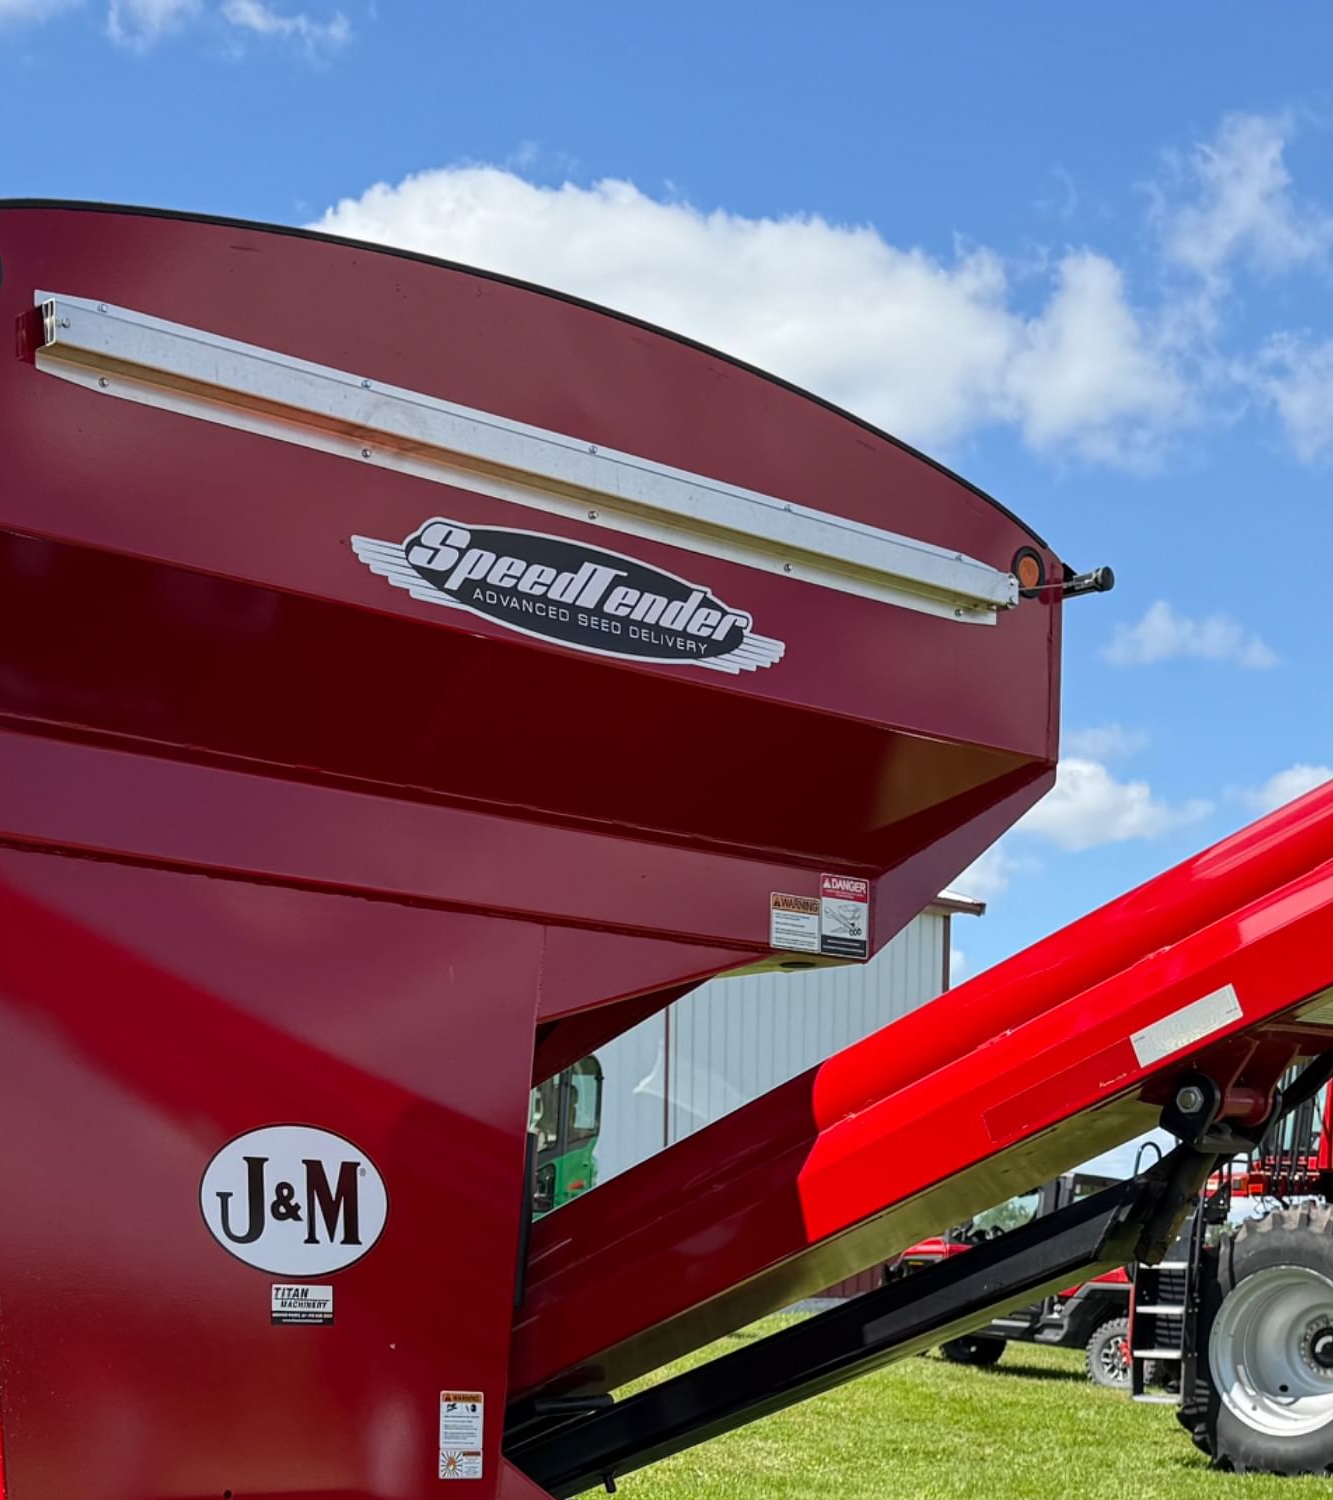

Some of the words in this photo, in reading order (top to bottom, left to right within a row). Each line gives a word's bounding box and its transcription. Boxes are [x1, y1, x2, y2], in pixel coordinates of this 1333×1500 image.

[407, 521, 749, 641] SpeedTender
[473, 588, 571, 622] ADVANCED
[578, 613, 622, 635] SEED
[629, 626, 708, 655] DELIVERY
[782, 897, 818, 912] WARNING
[831, 878, 866, 893] DANGER
[216, 1156, 362, 1245] J&M
[274, 1287, 309, 1298] TITAN
